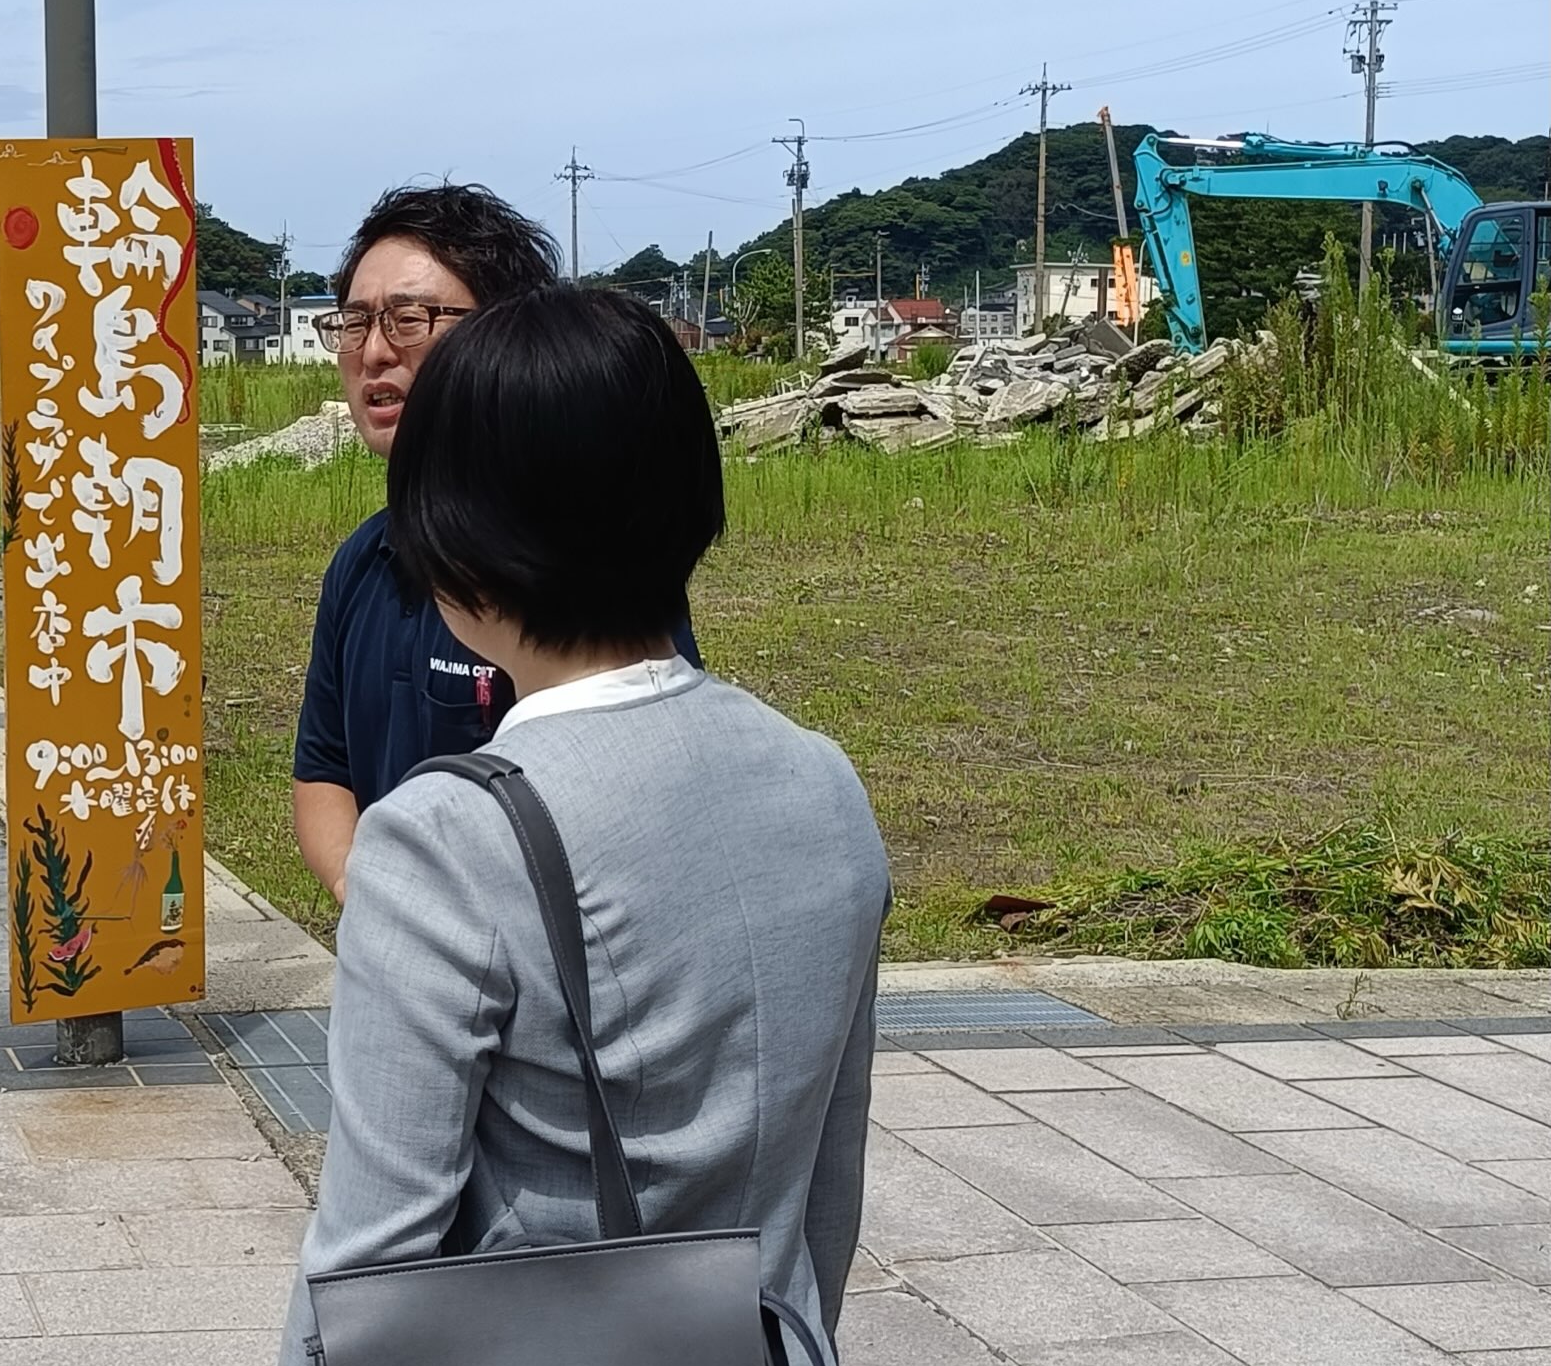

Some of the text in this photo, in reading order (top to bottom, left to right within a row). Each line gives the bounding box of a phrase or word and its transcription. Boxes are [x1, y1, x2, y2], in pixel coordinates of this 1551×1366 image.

[23, 278, 76, 707] ワイプラザで出店中
[57, 155, 186, 741] 輪島朝市
[59, 774, 197, 821] 水曜定休
